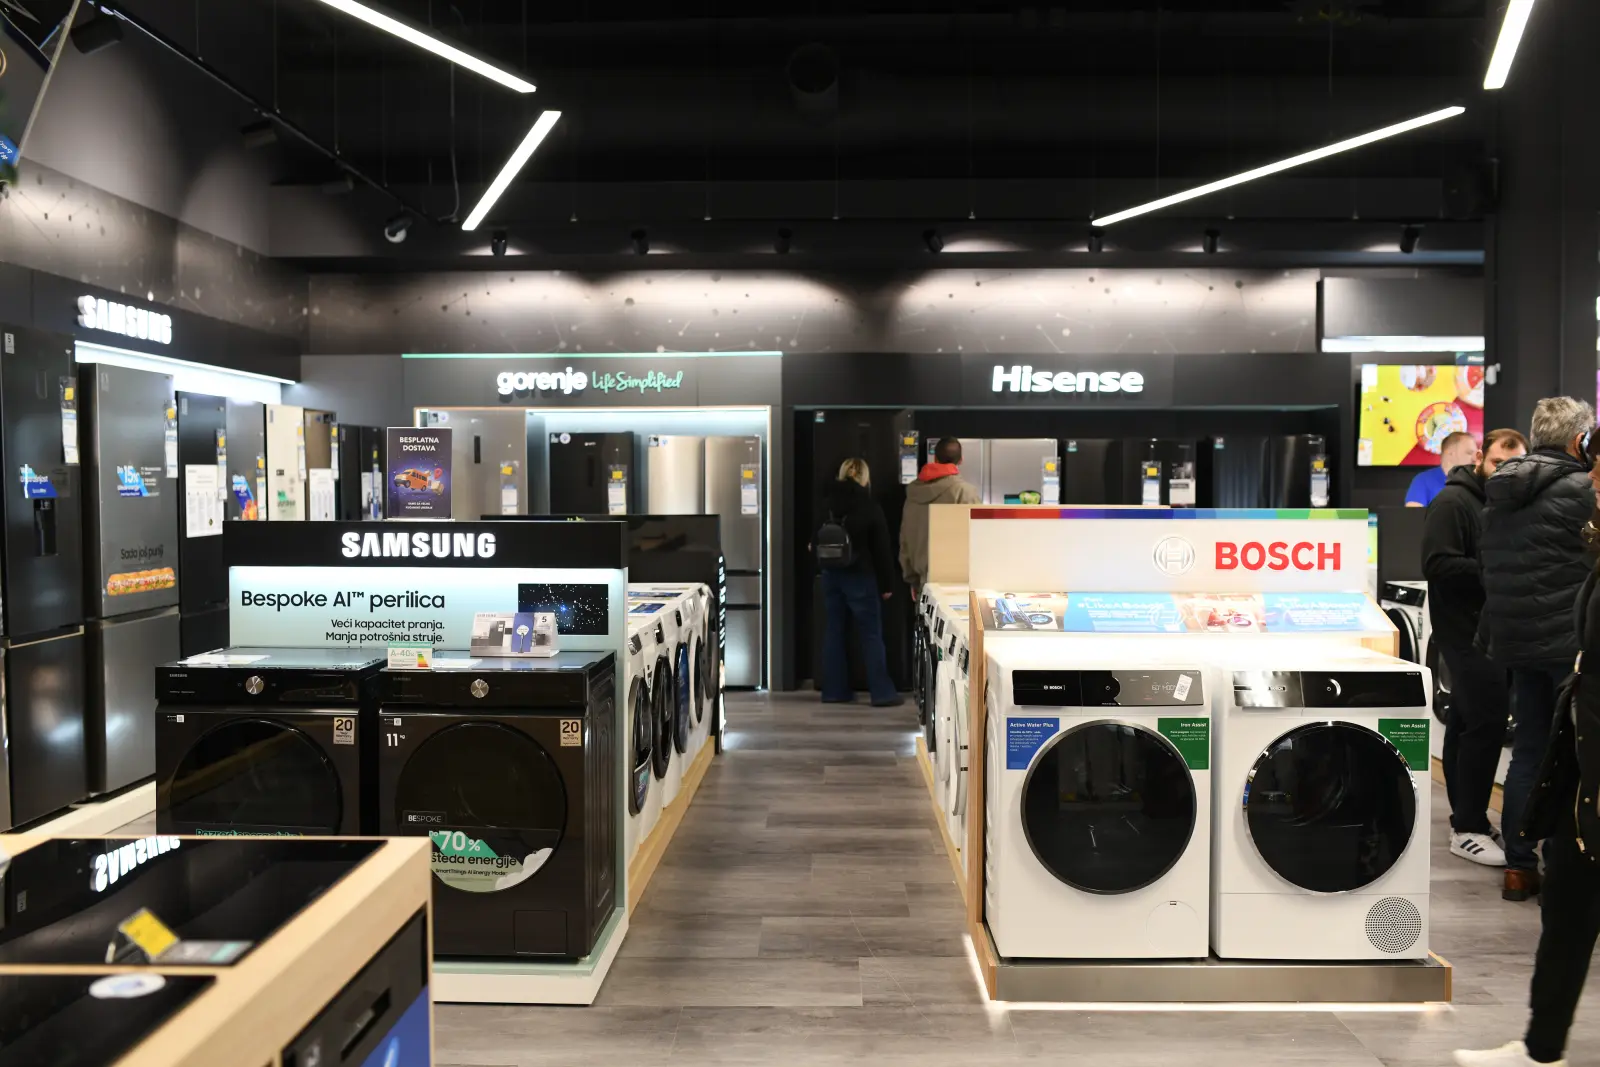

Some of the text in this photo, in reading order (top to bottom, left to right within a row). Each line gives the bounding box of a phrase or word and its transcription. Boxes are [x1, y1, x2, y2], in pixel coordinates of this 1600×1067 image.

[80, 295, 171, 344] SAMSUNG
[497, 366, 588, 394] gorenje
[992, 365, 1144, 392] Hisense
[341, 532, 496, 558] SAMSUNG
[1215, 541, 1341, 570] BOSCH
[241, 590, 327, 612] Bespoke
[370, 590, 445, 612] perilica
[331, 619, 445, 631] Veći kapacitet pranja.
[326, 632, 357, 643] Manja
[412, 633, 445, 644] struje.
[336, 719, 352, 731] 20
[562, 721, 579, 733] 20
[386, 733, 398, 747] 11
[431, 852, 517, 868] šteda energije
